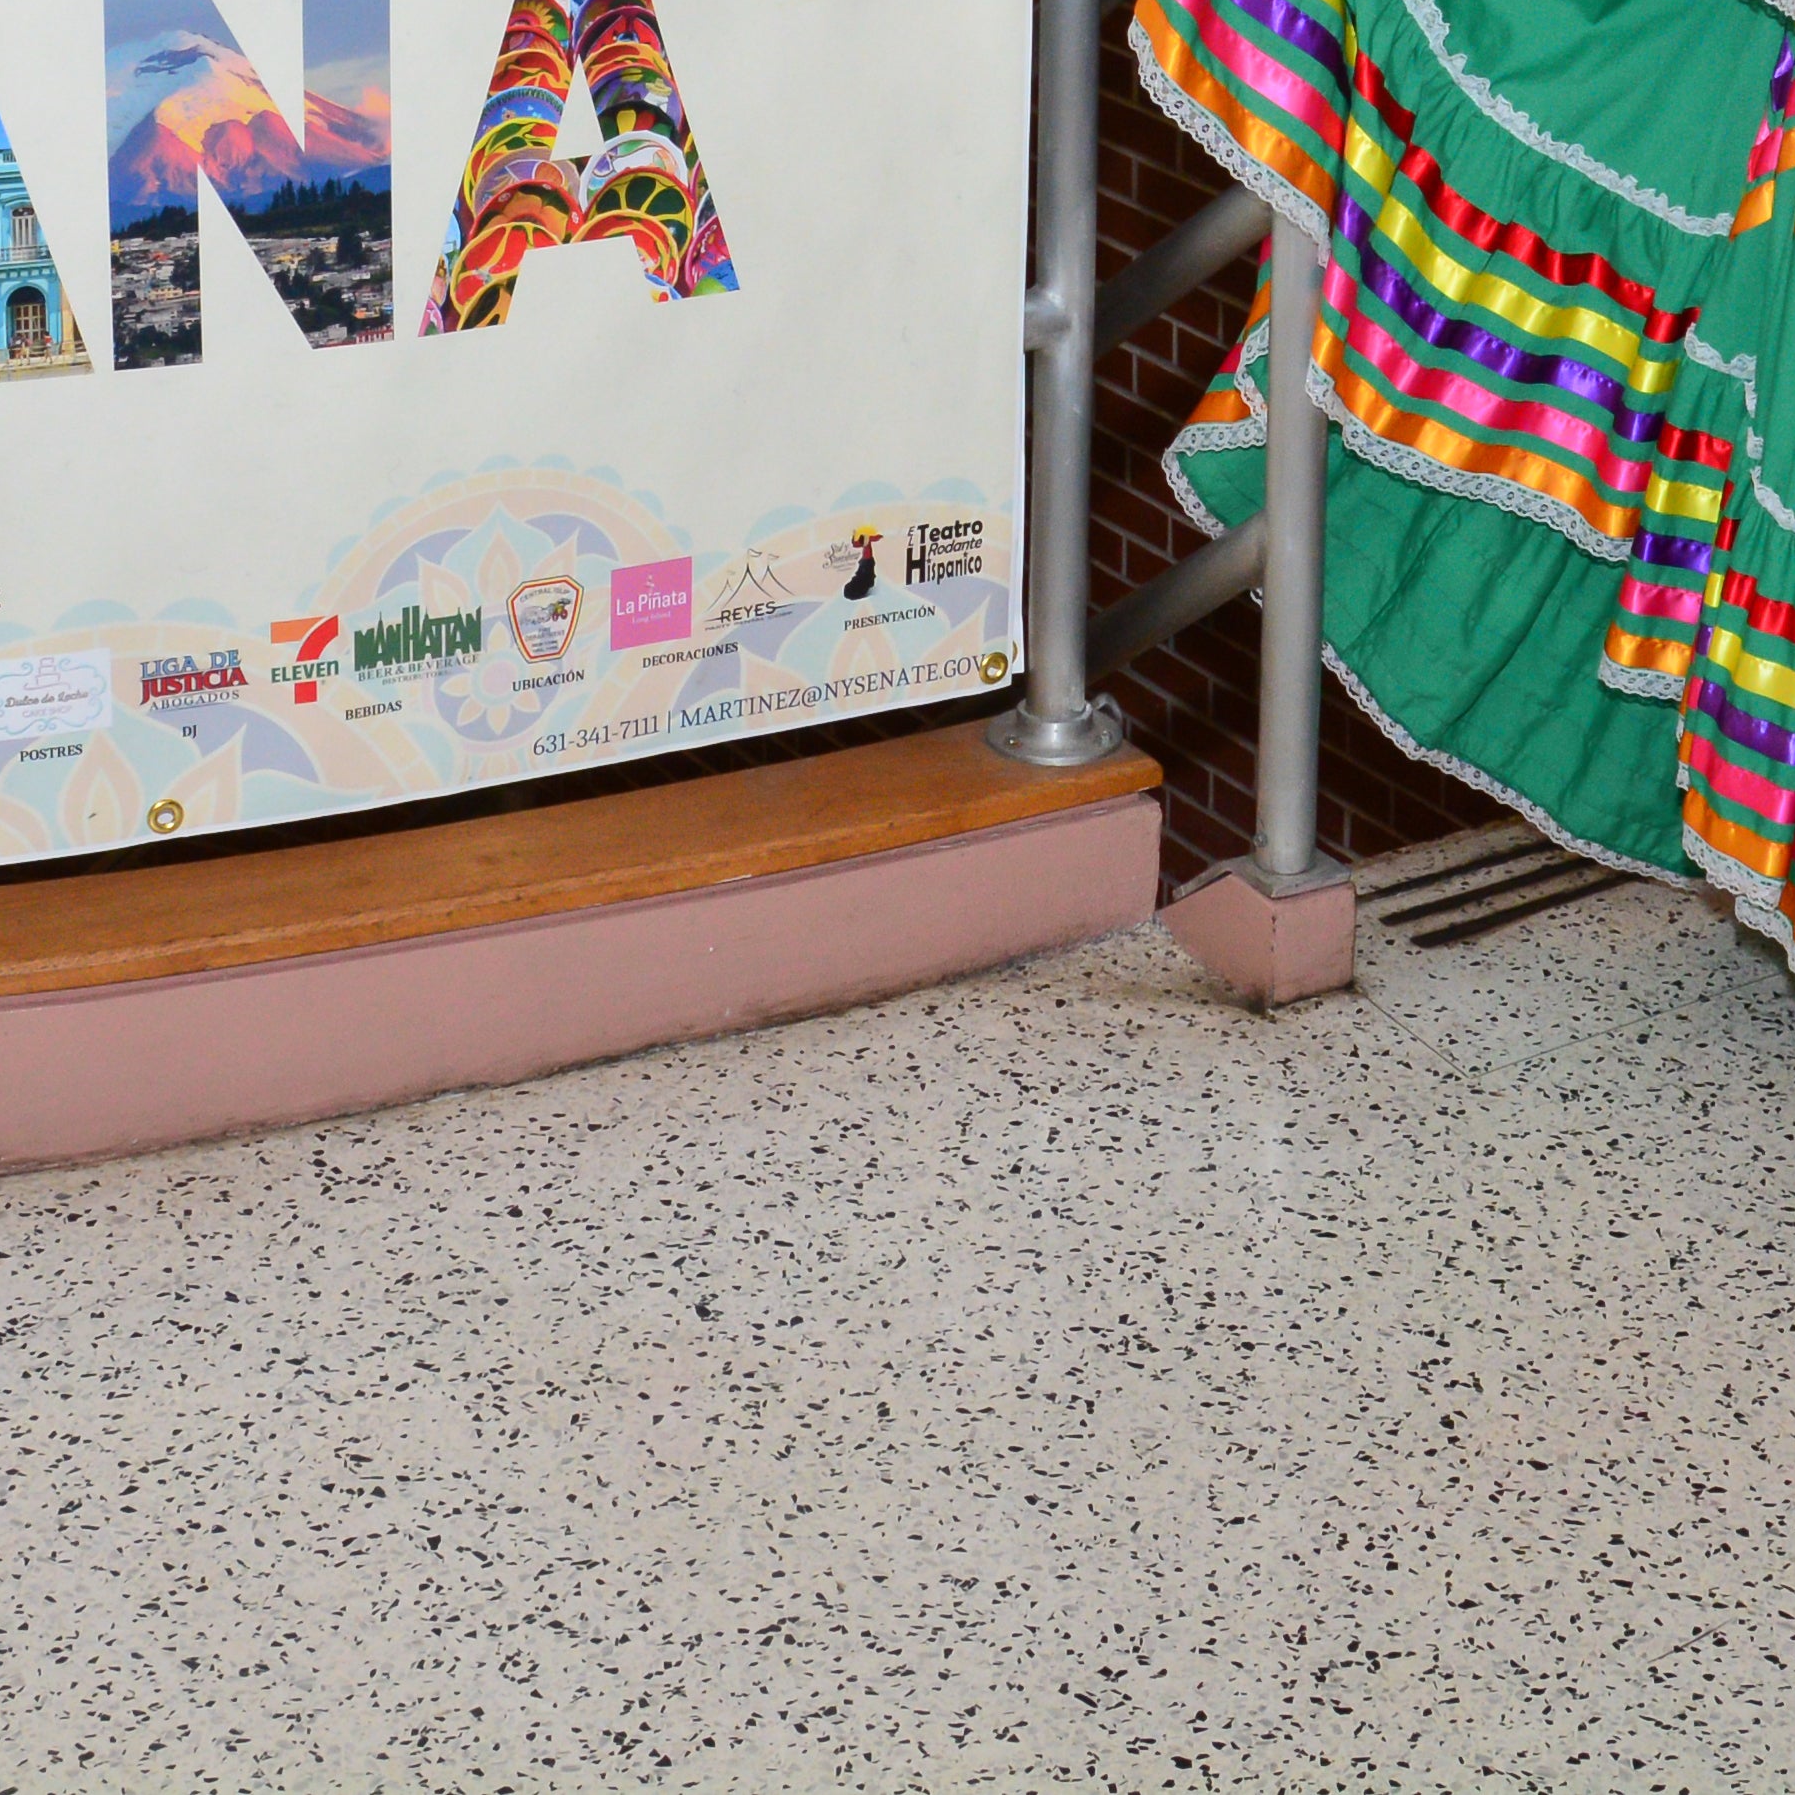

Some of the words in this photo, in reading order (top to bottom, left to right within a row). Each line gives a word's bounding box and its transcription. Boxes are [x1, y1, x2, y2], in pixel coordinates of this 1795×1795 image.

[915, 518, 984, 545] Teatro
[927, 537, 984, 558] Rodante
[905, 544, 984, 586] Hispanico
[615, 598, 635, 617] La
[637, 590, 688, 613] Piñata
[719, 600, 778, 624] REYES
[843, 604, 937, 632] PRESENTACIÓN
[353, 605, 482, 673] MANHATTAN
[140, 655, 199, 679] LIGA
[209, 649, 242, 669] DE
[270, 614, 339, 705] 7
[357, 667, 394, 683] BEER
[394, 665, 405, 676] &
[407, 654, 480, 674] BEVERAGE
[642, 640, 740, 670] DECORACIONES
[139, 666, 250, 706] JUSTICIA
[512, 669, 585, 693] UBICACIÓN
[149, 689, 241, 713] ABOGADOS
[345, 700, 404, 721] BEBIDAS
[532, 713, 661, 758] 631-341-7111
[678, 652, 987, 730] MARTINEZ@NYSENATE.GOV
[182, 724, 198, 740] DJ
[19, 743, 84, 763] POSTRES
